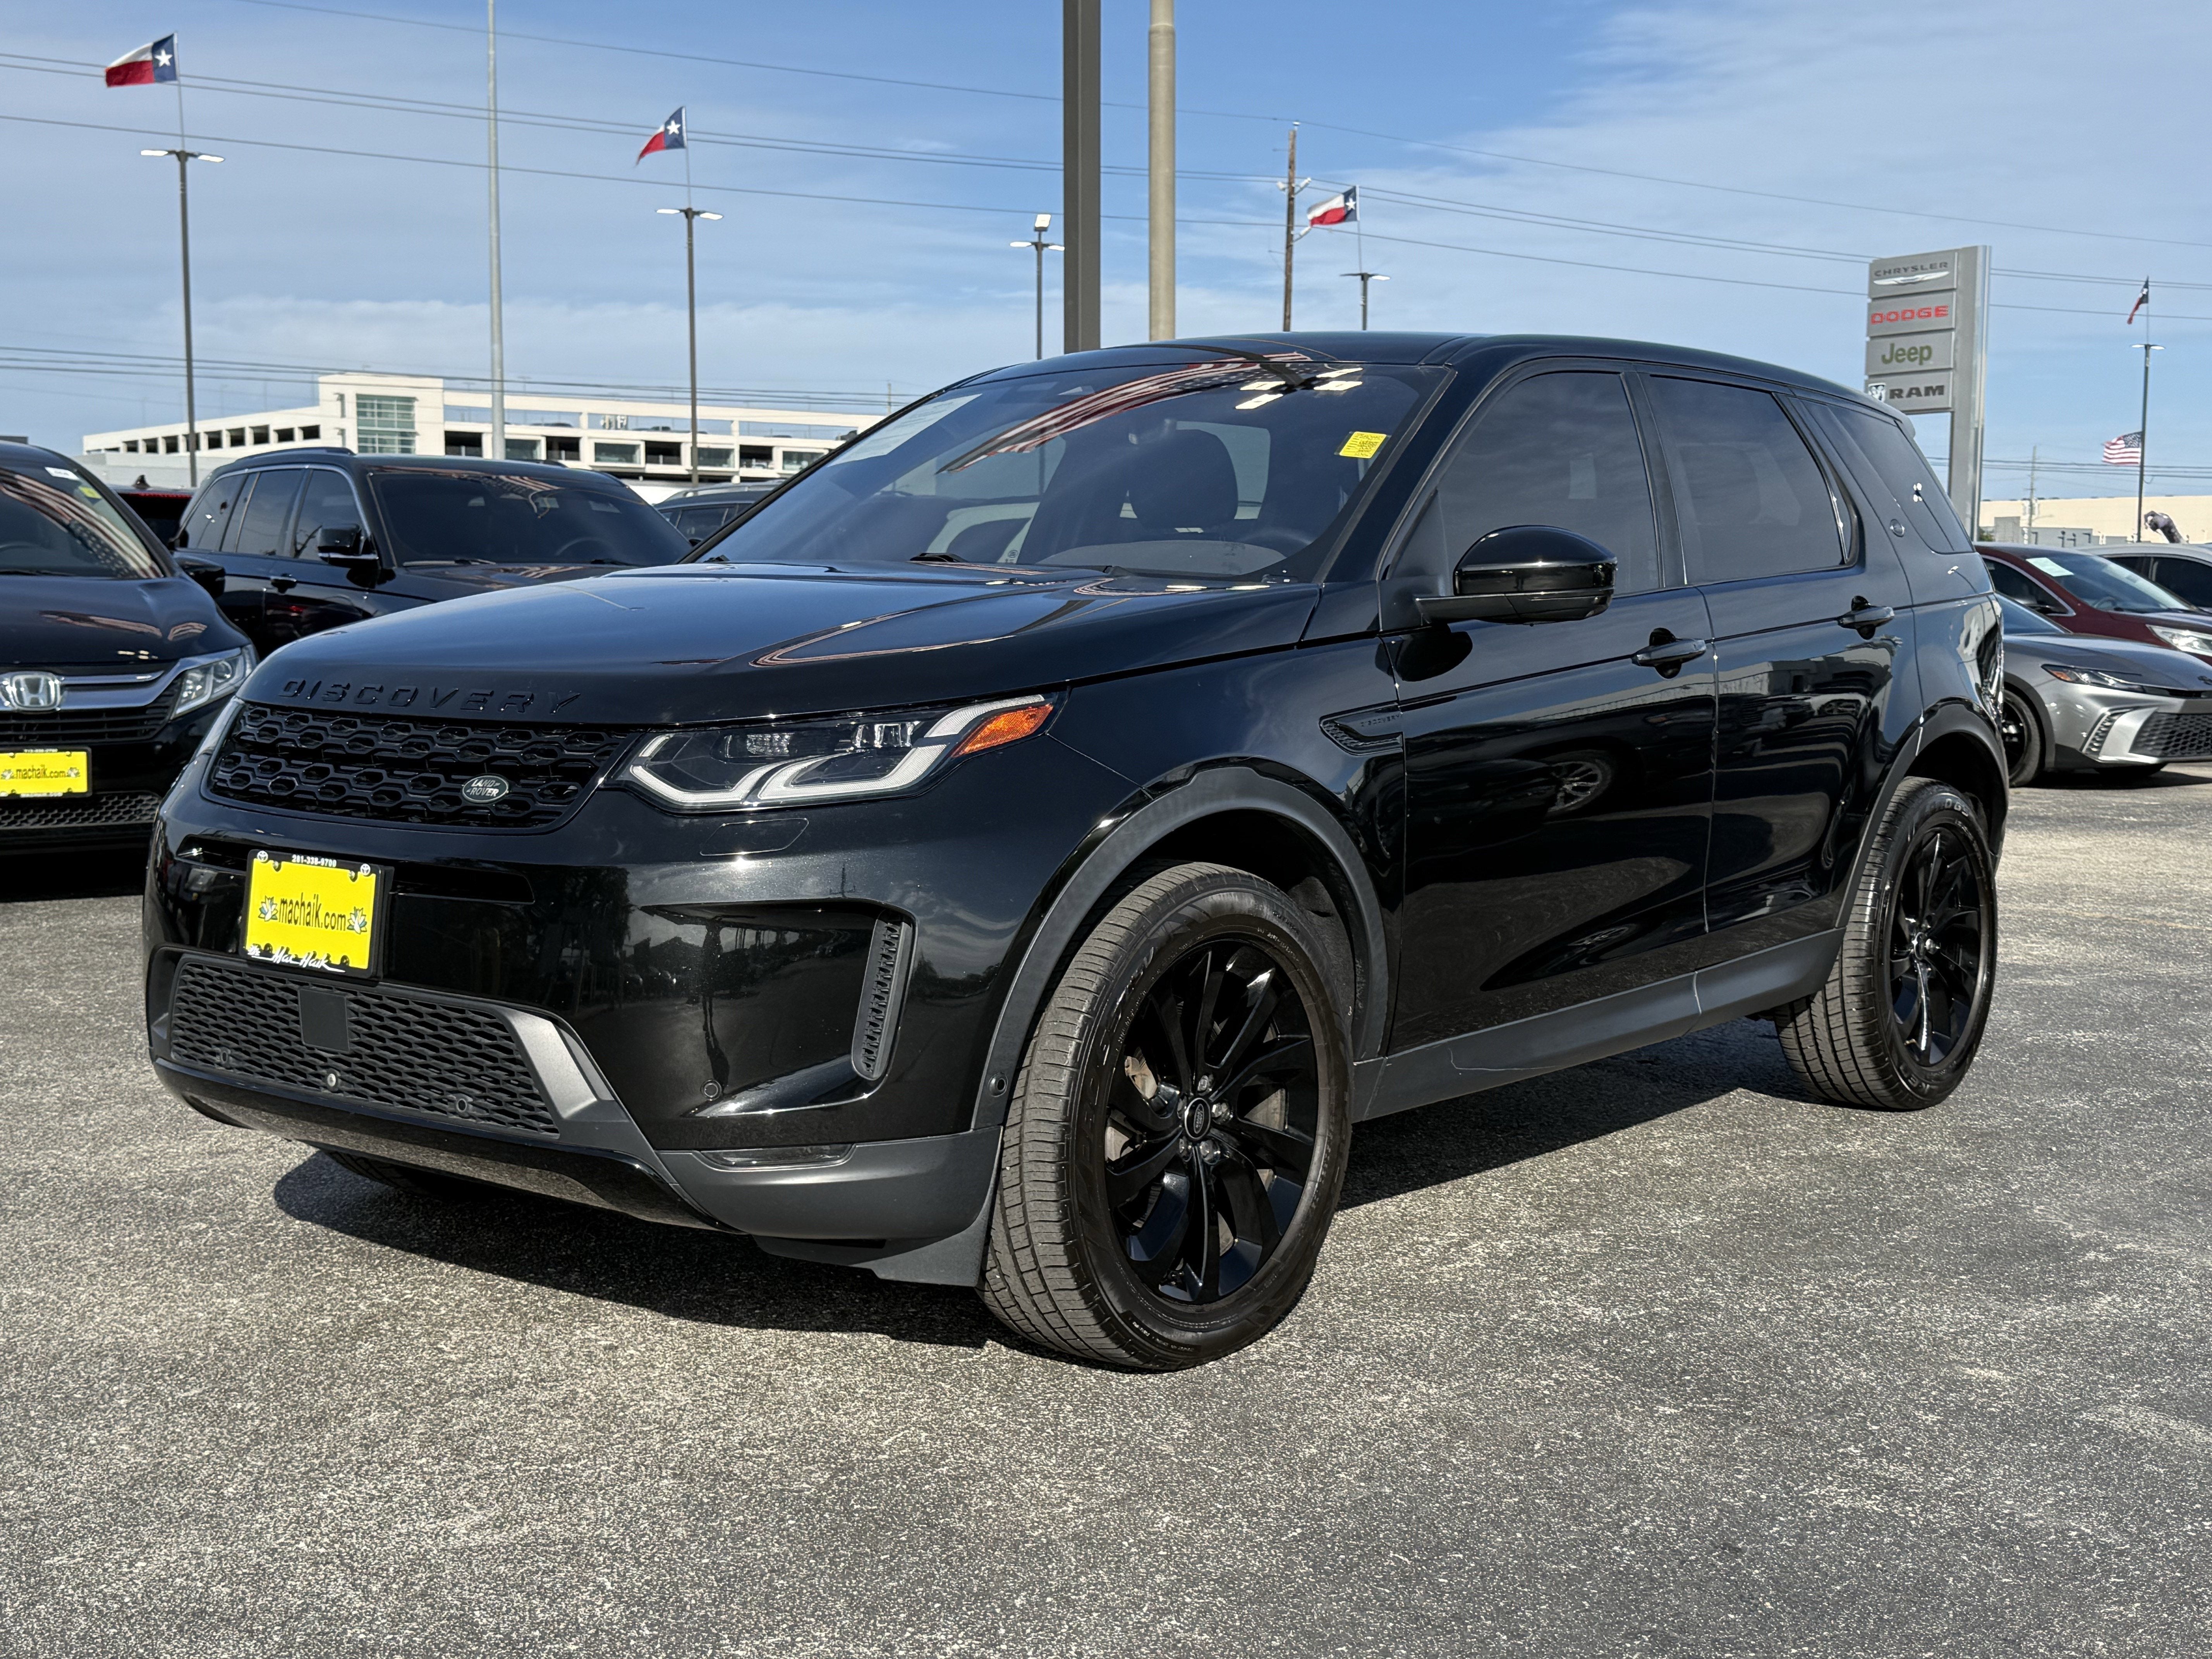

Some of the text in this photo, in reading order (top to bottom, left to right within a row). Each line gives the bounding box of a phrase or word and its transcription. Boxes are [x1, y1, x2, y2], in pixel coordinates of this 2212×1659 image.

[1874, 261, 1948, 277] CHRYSLER
[1870, 305, 1949, 325] DODGE
[1881, 343, 1932, 365] Jeep
[1889, 385, 1945, 399] RAM
[279, 678, 581, 715] DISCOVERY
[471, 779, 496, 787] LAND
[470, 787, 499, 797] ROVER
[278, 892, 346, 931] machaik.com
[271, 947, 297, 964] Mac
